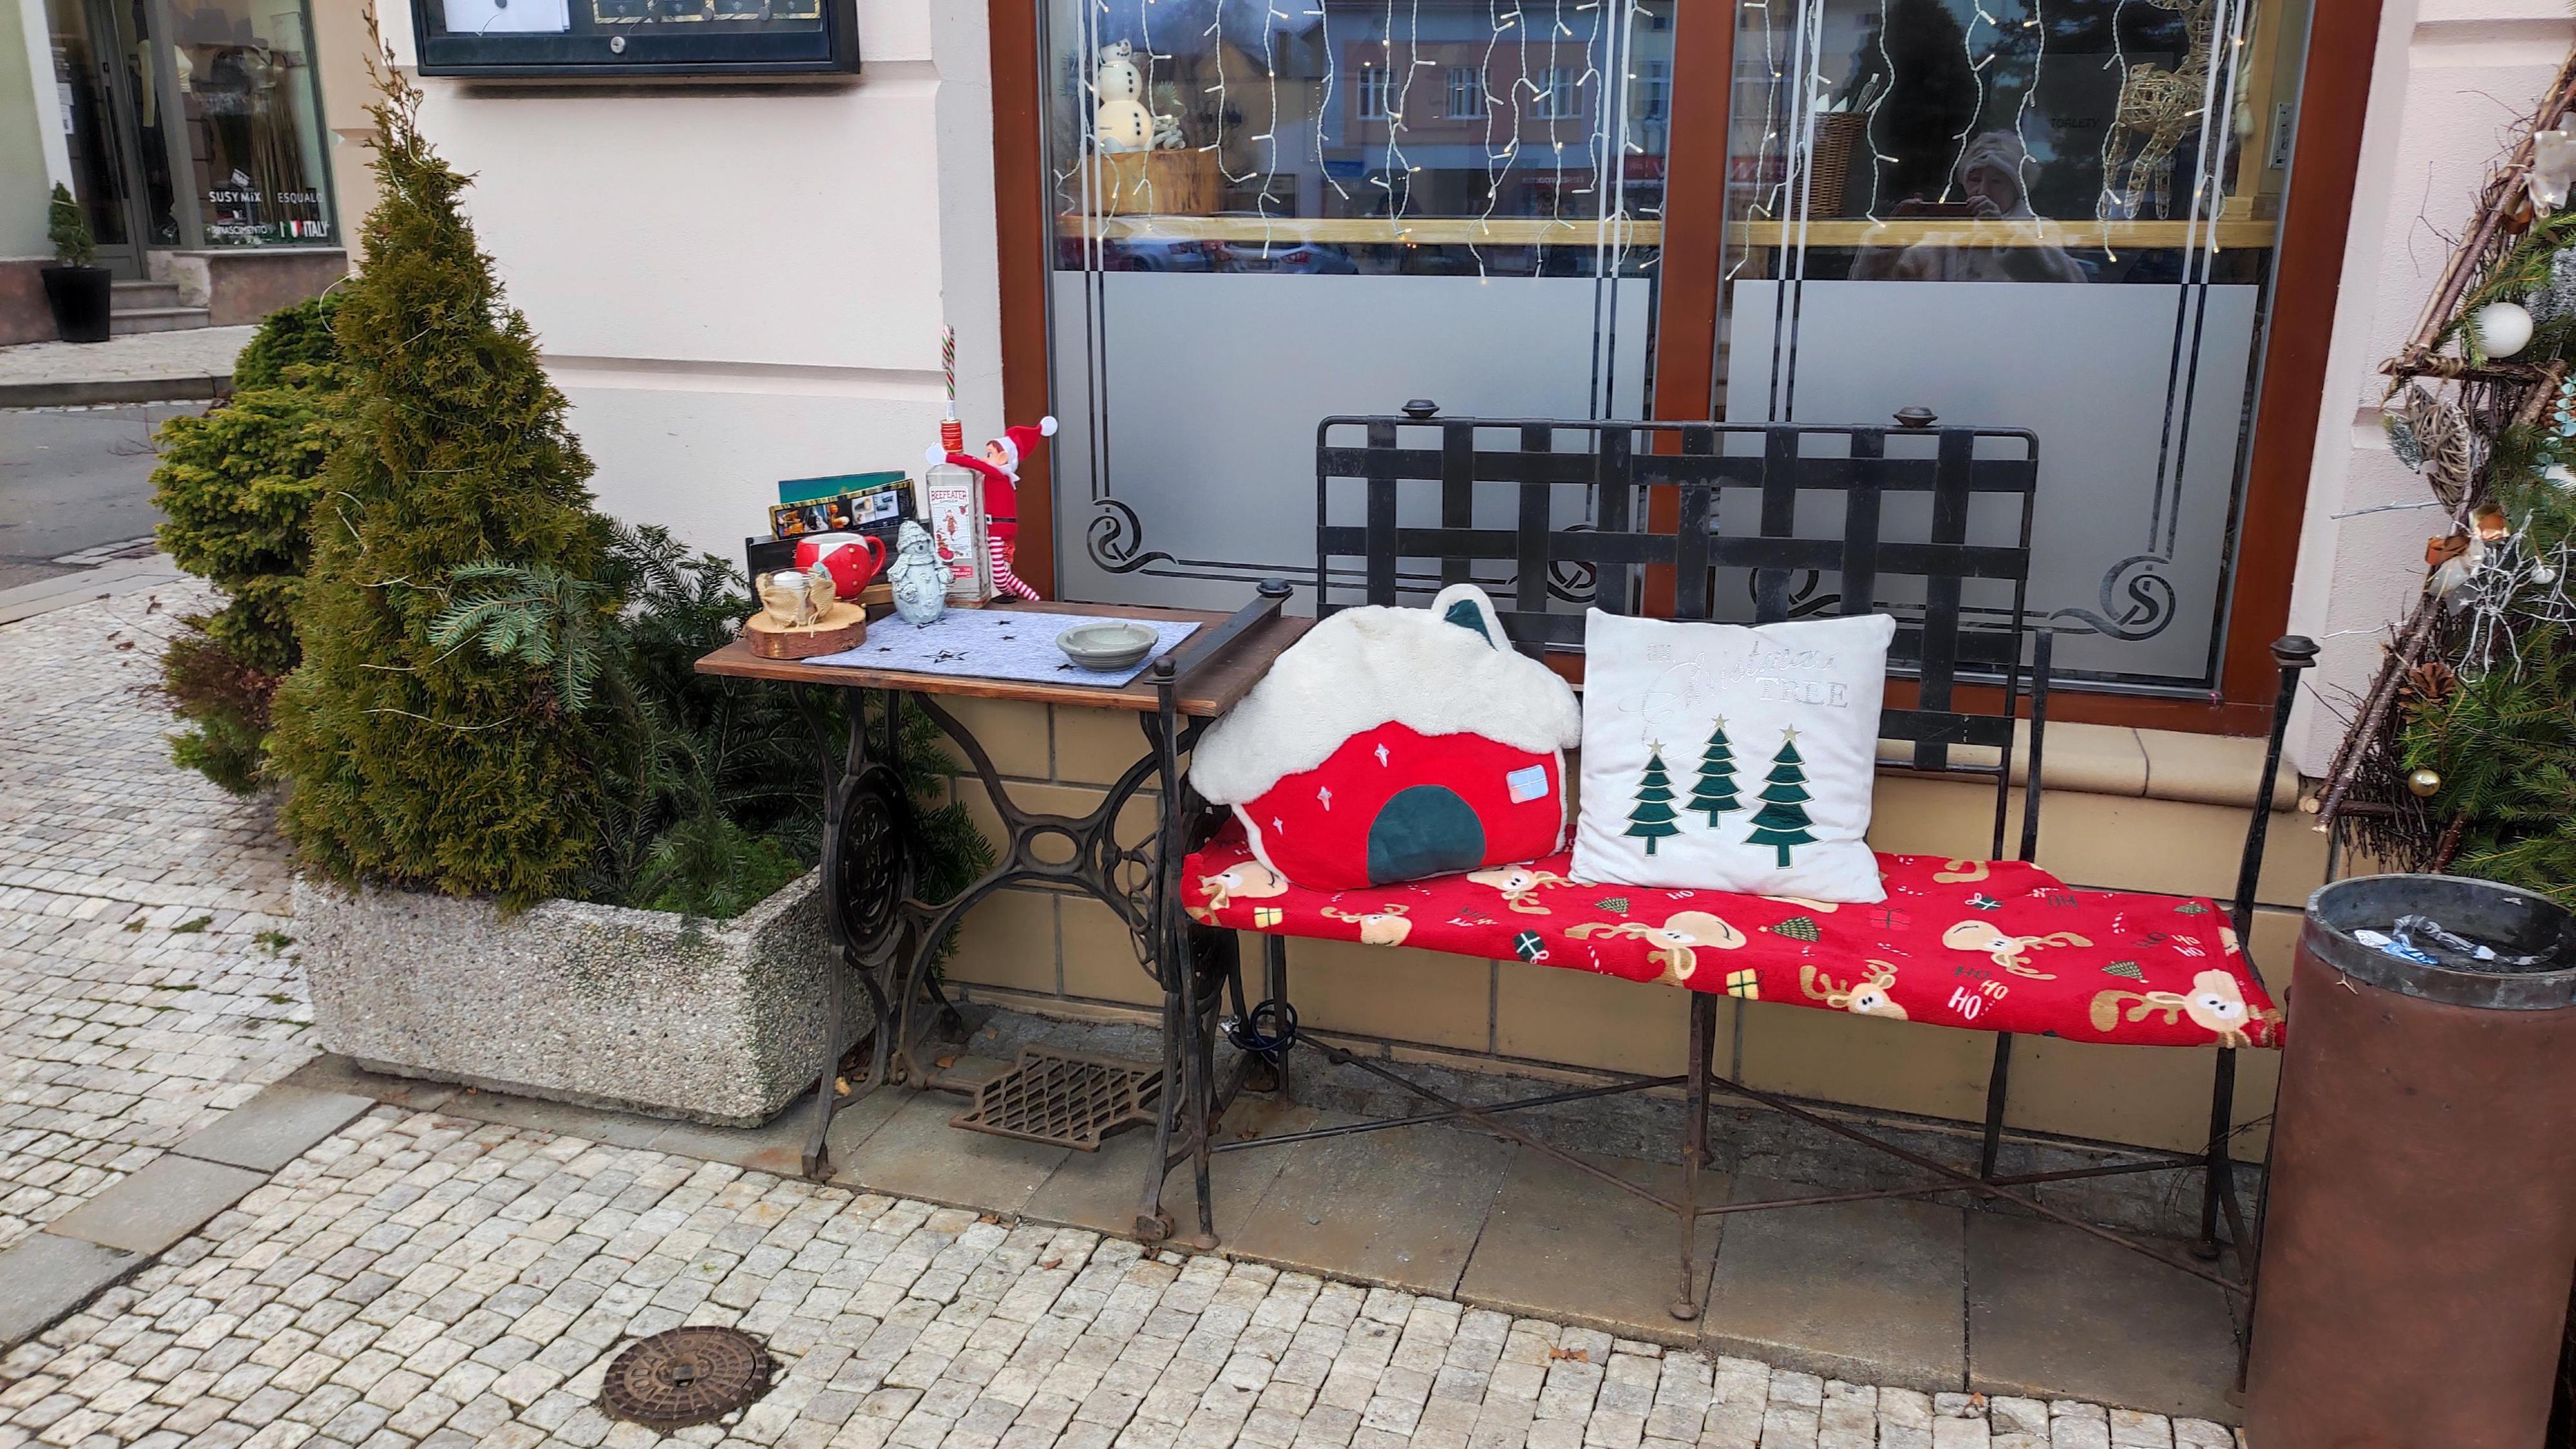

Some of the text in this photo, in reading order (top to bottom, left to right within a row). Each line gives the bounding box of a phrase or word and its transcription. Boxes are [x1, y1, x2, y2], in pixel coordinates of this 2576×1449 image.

[209, 193, 238, 202] SUSY
[278, 193, 323, 203] ESQUALO
[303, 220, 330, 238] ITALY
[931, 490, 967, 501] BEEFEATER
[1755, 676, 1848, 708] TREE
[1665, 890, 1695, 900] HO
[1955, 965, 1990, 980] HO
[1979, 980, 2009, 1000] HO
[1947, 985, 1982, 1020] HO
